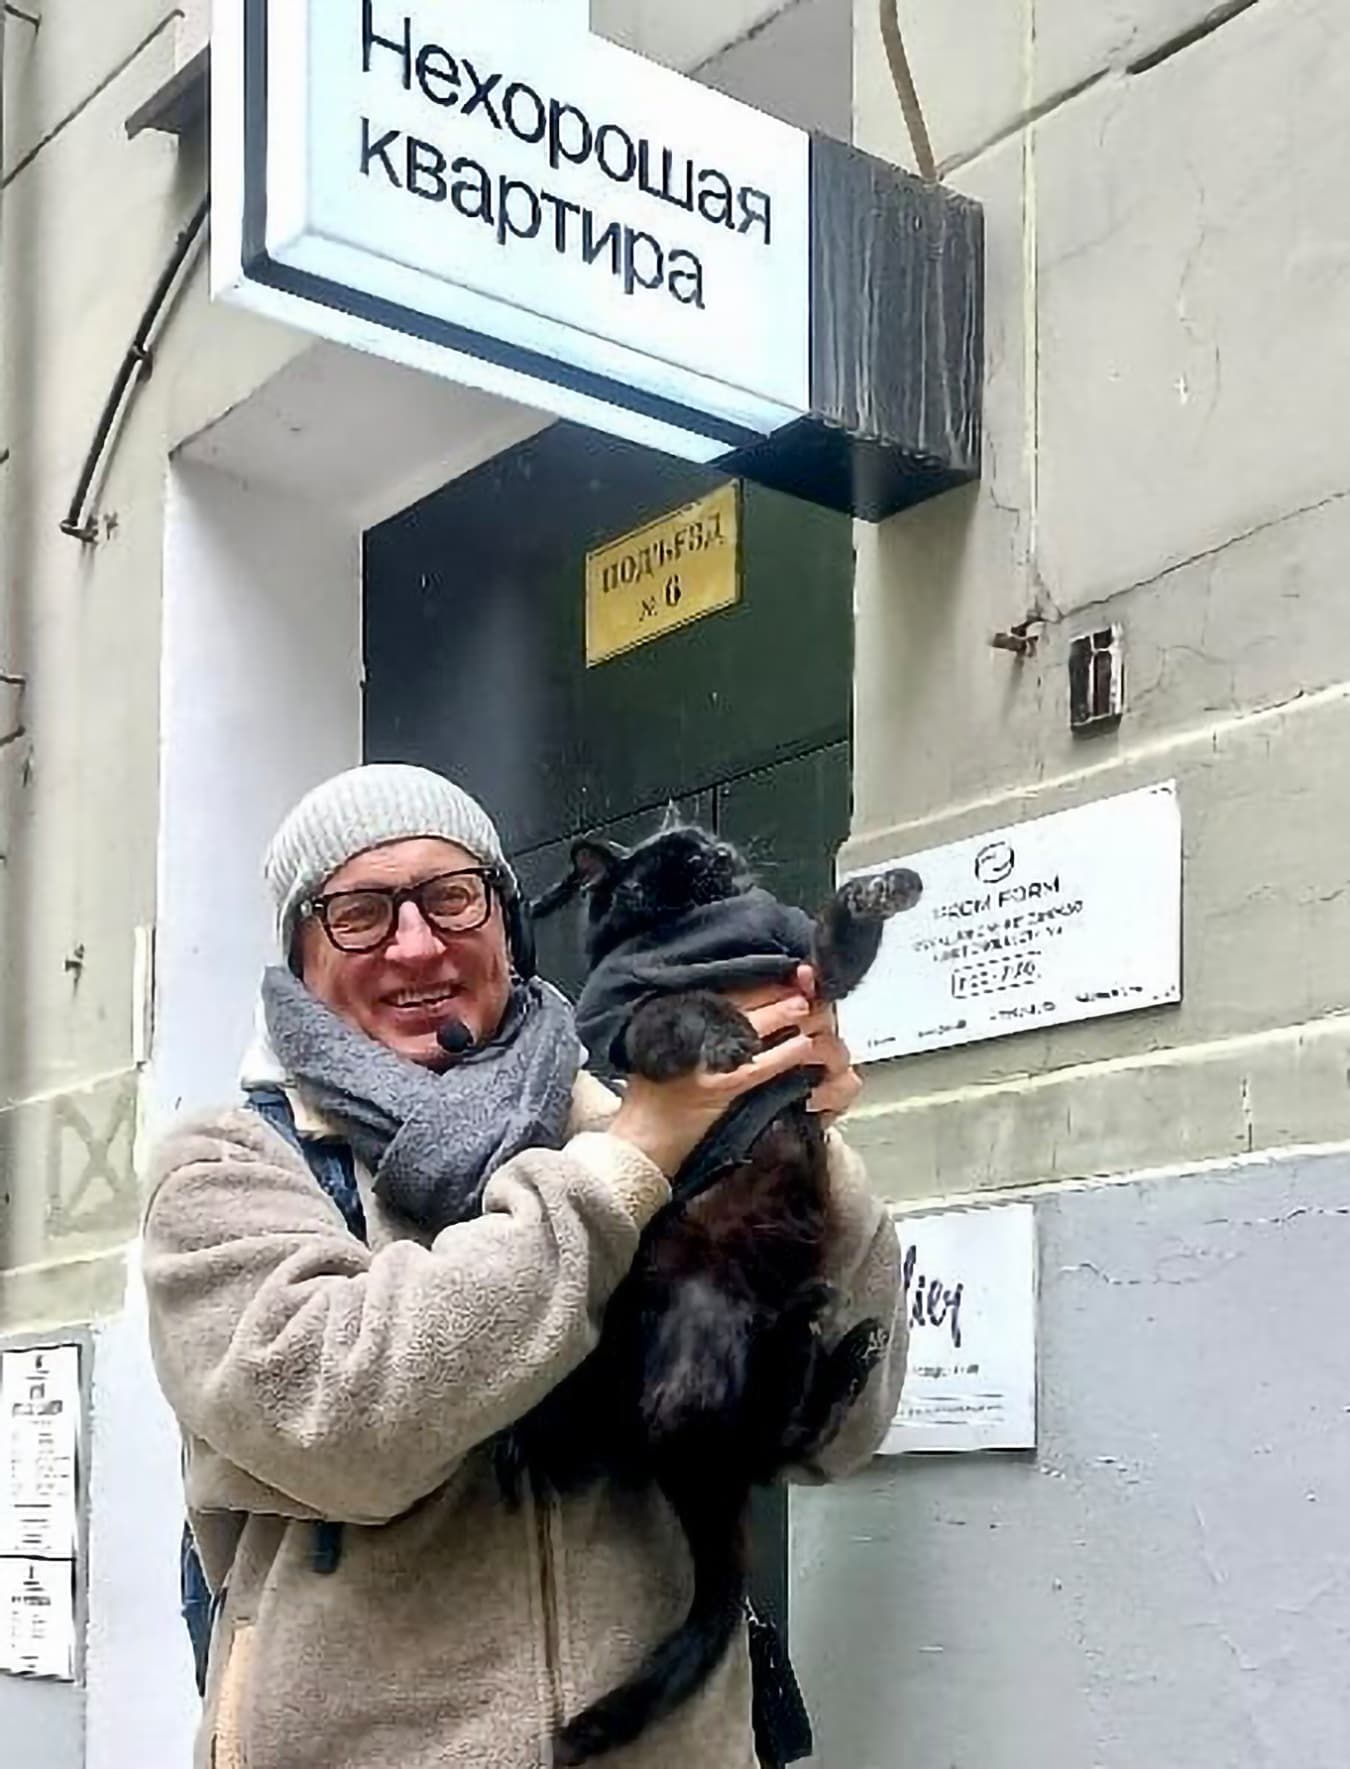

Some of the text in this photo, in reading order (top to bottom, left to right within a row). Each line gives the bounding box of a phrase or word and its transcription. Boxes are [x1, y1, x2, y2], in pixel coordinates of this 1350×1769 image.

[359, 116, 706, 310] квартира
[361, 0, 771, 245] Нехорошая
[665, 574, 682, 608] 6
